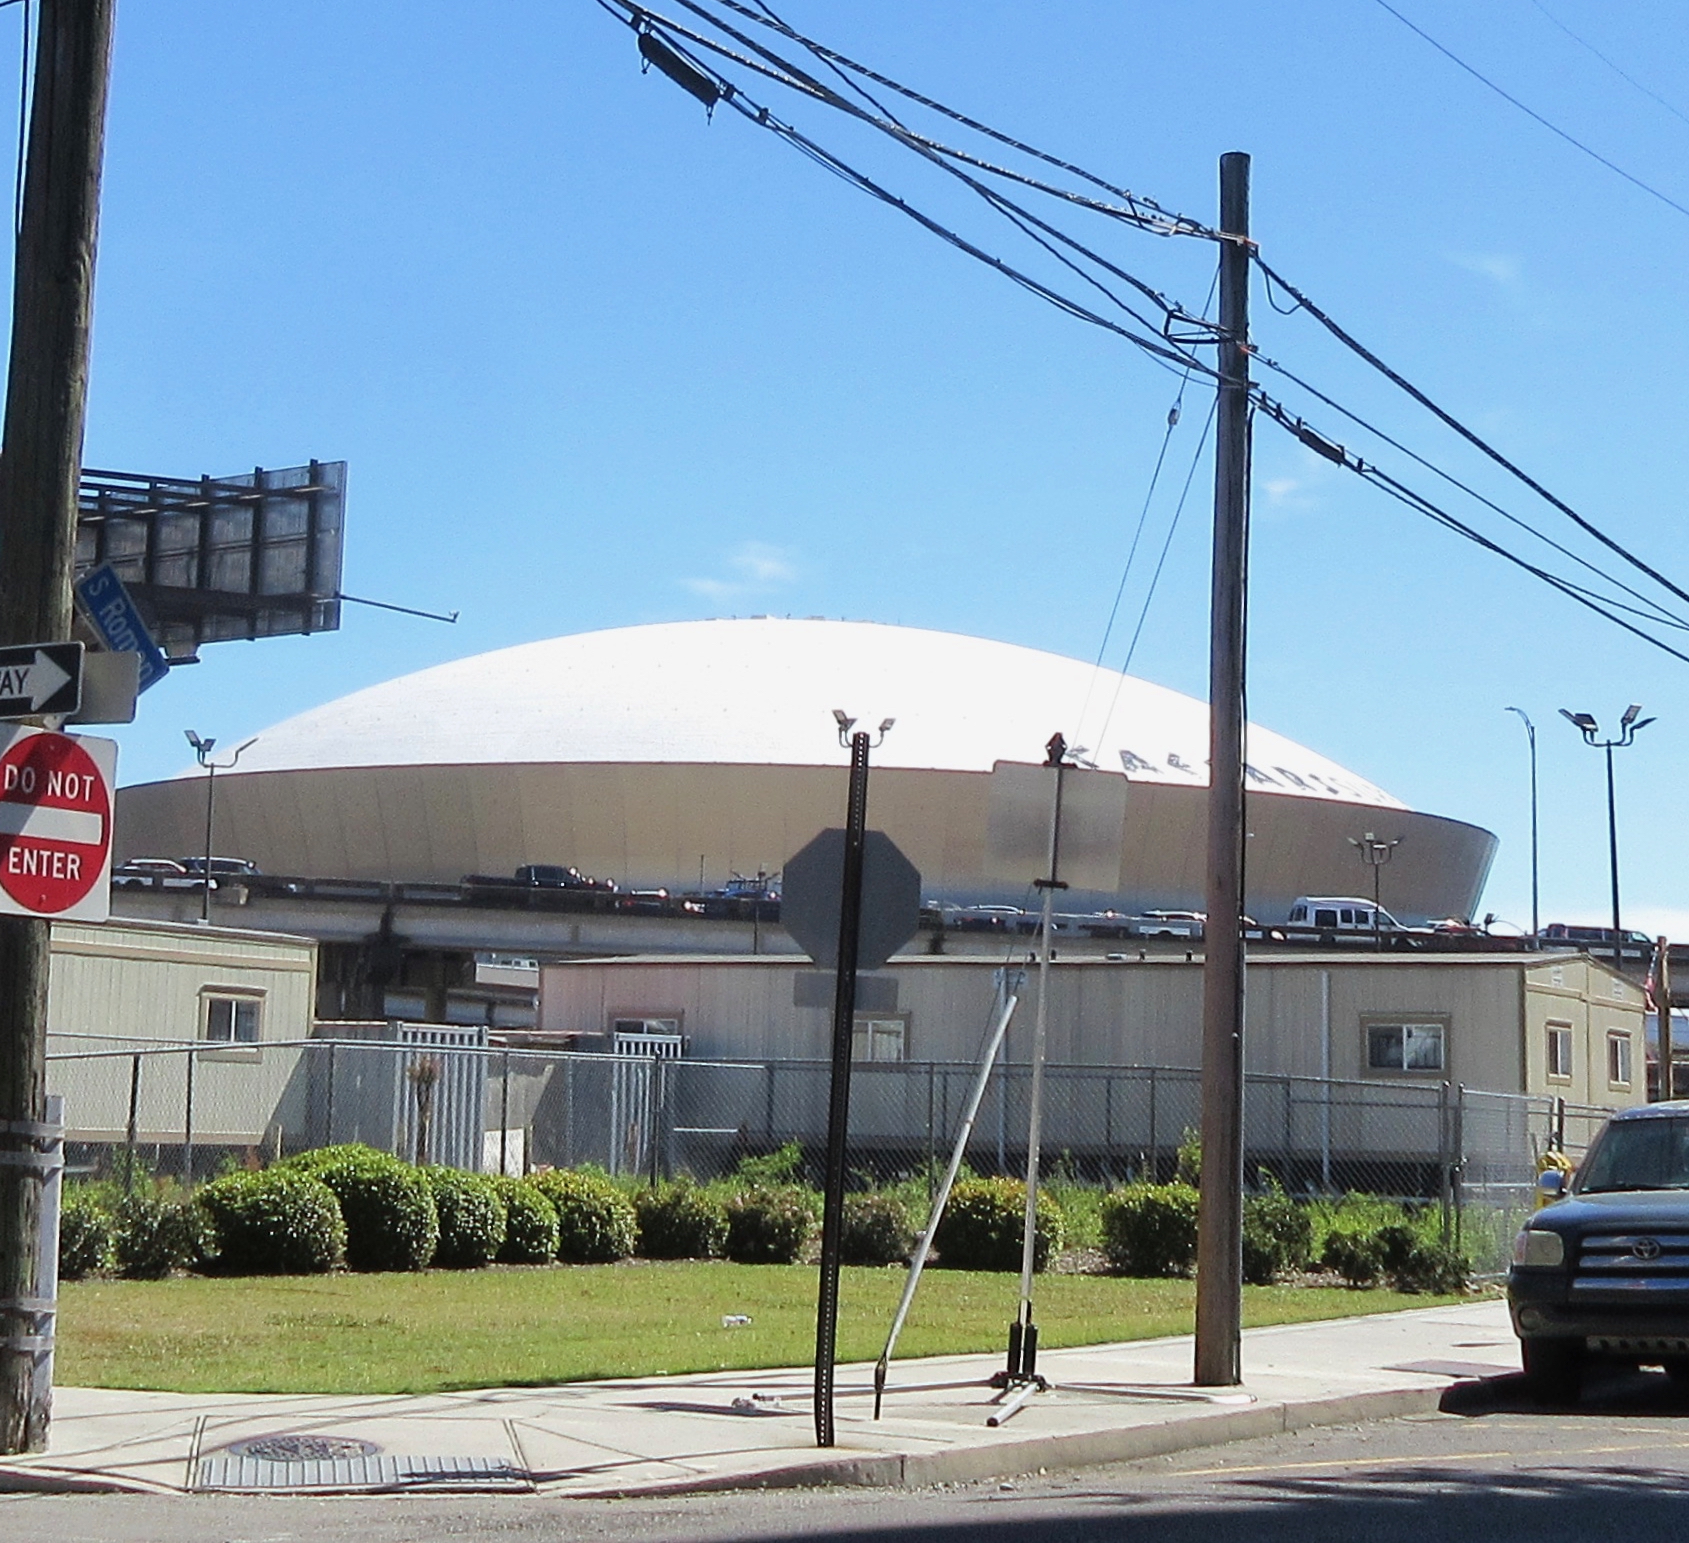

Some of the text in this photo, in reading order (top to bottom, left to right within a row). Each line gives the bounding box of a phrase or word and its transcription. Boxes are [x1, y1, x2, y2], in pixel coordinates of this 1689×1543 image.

[88, 577, 153, 681] S Romn
[4, 764, 95, 802] DO NOT
[8, 847, 81, 881] ENTER
